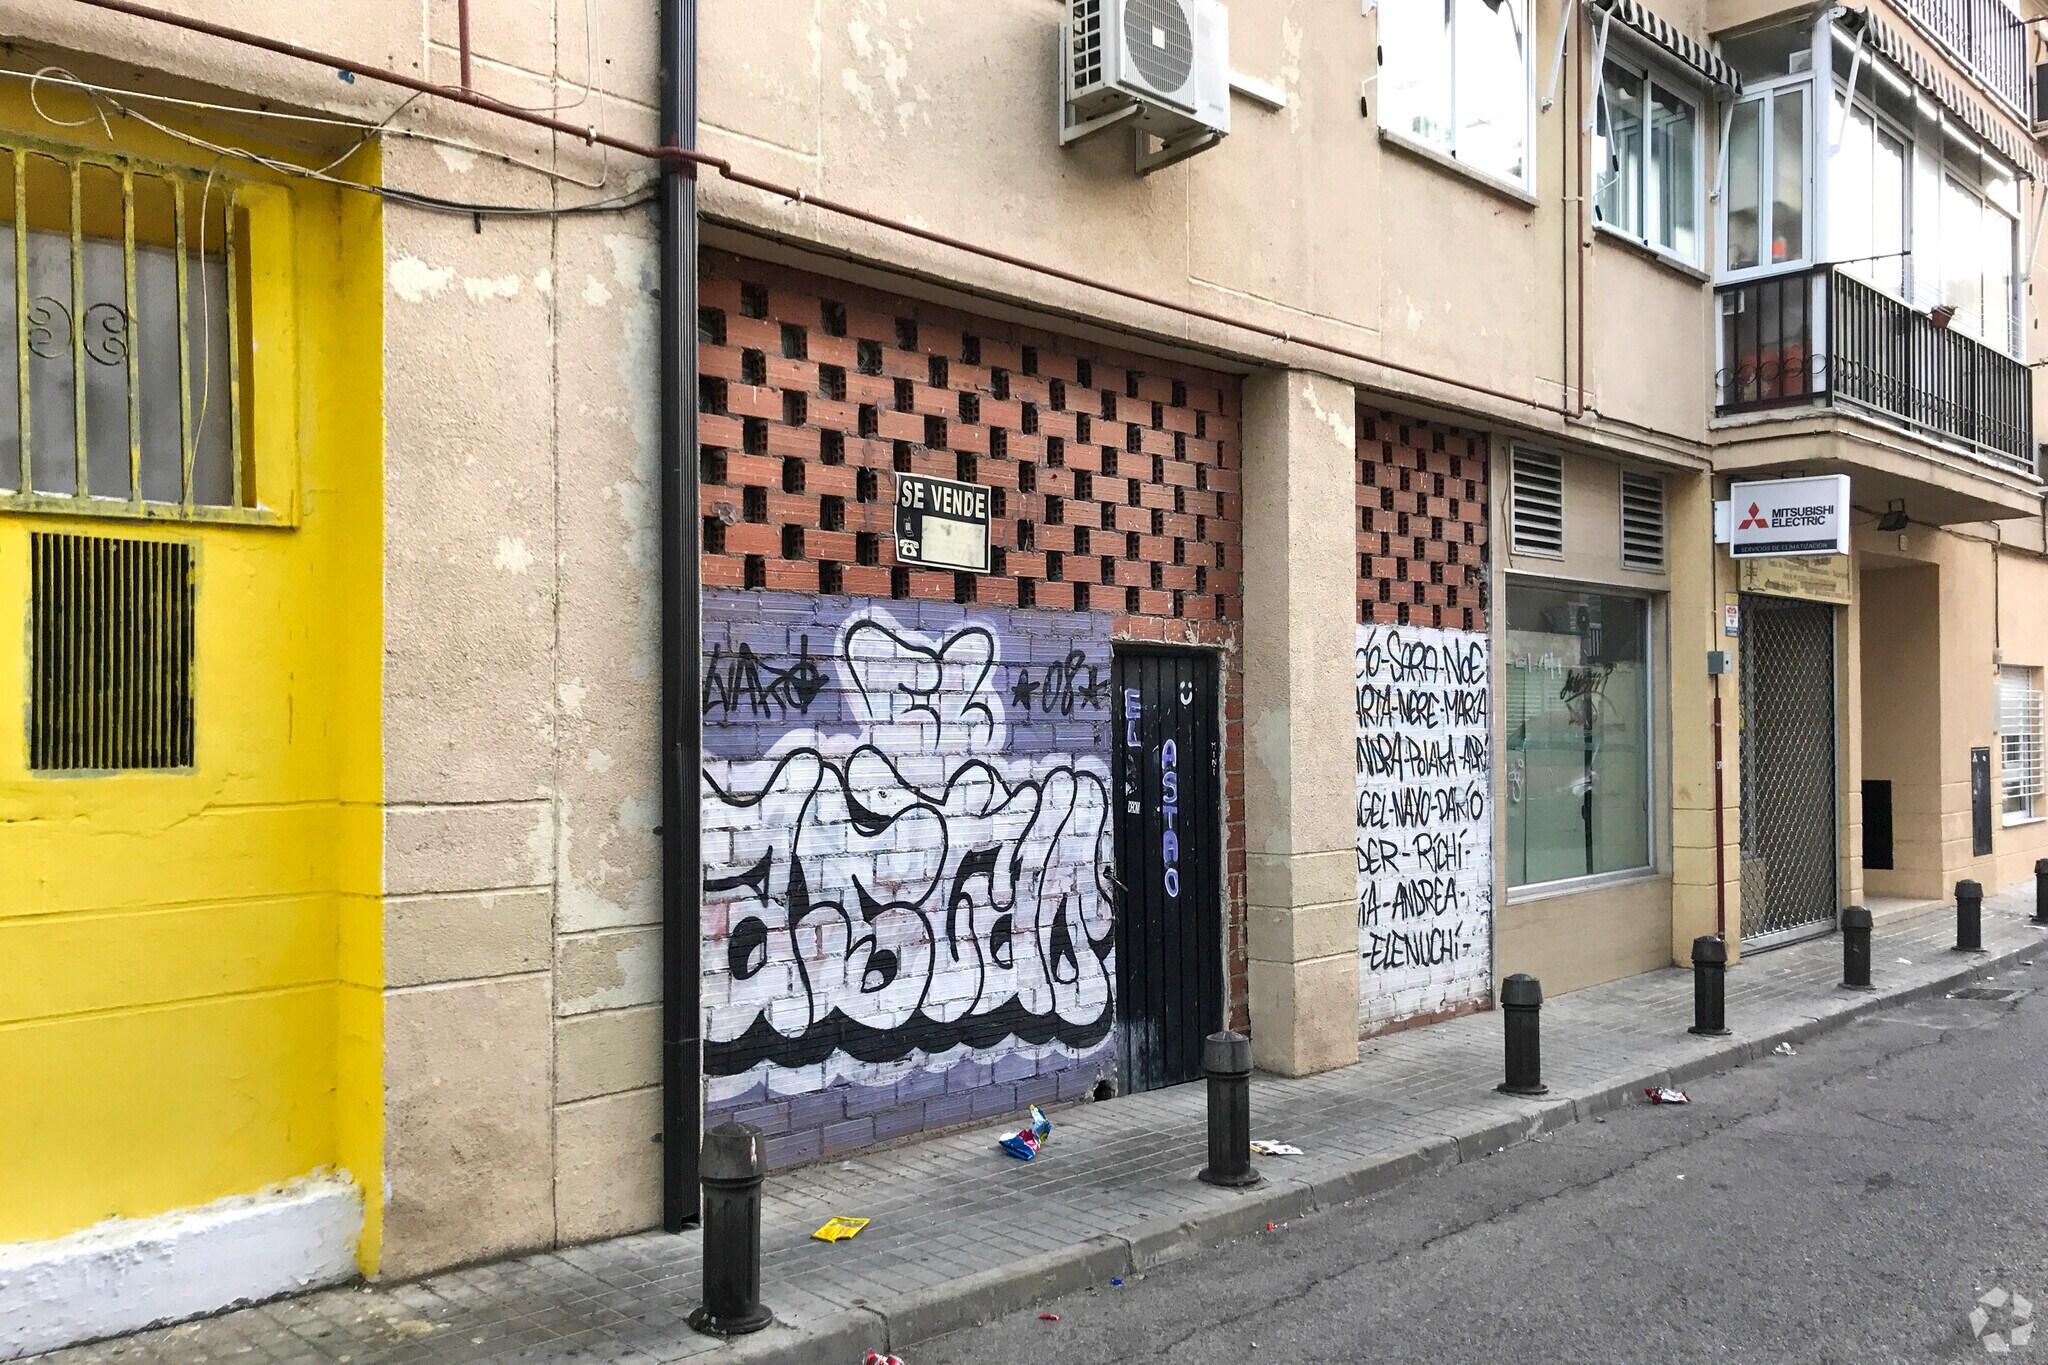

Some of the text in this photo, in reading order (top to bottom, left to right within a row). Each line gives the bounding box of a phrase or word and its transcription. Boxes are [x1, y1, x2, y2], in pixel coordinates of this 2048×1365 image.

[901, 480, 986, 519] SE VENDE
[1771, 504, 1834, 518] MITSUBISHI
[1771, 515, 1826, 528] ELECTRIC
[1741, 545, 1771, 553] SERVICIOS
